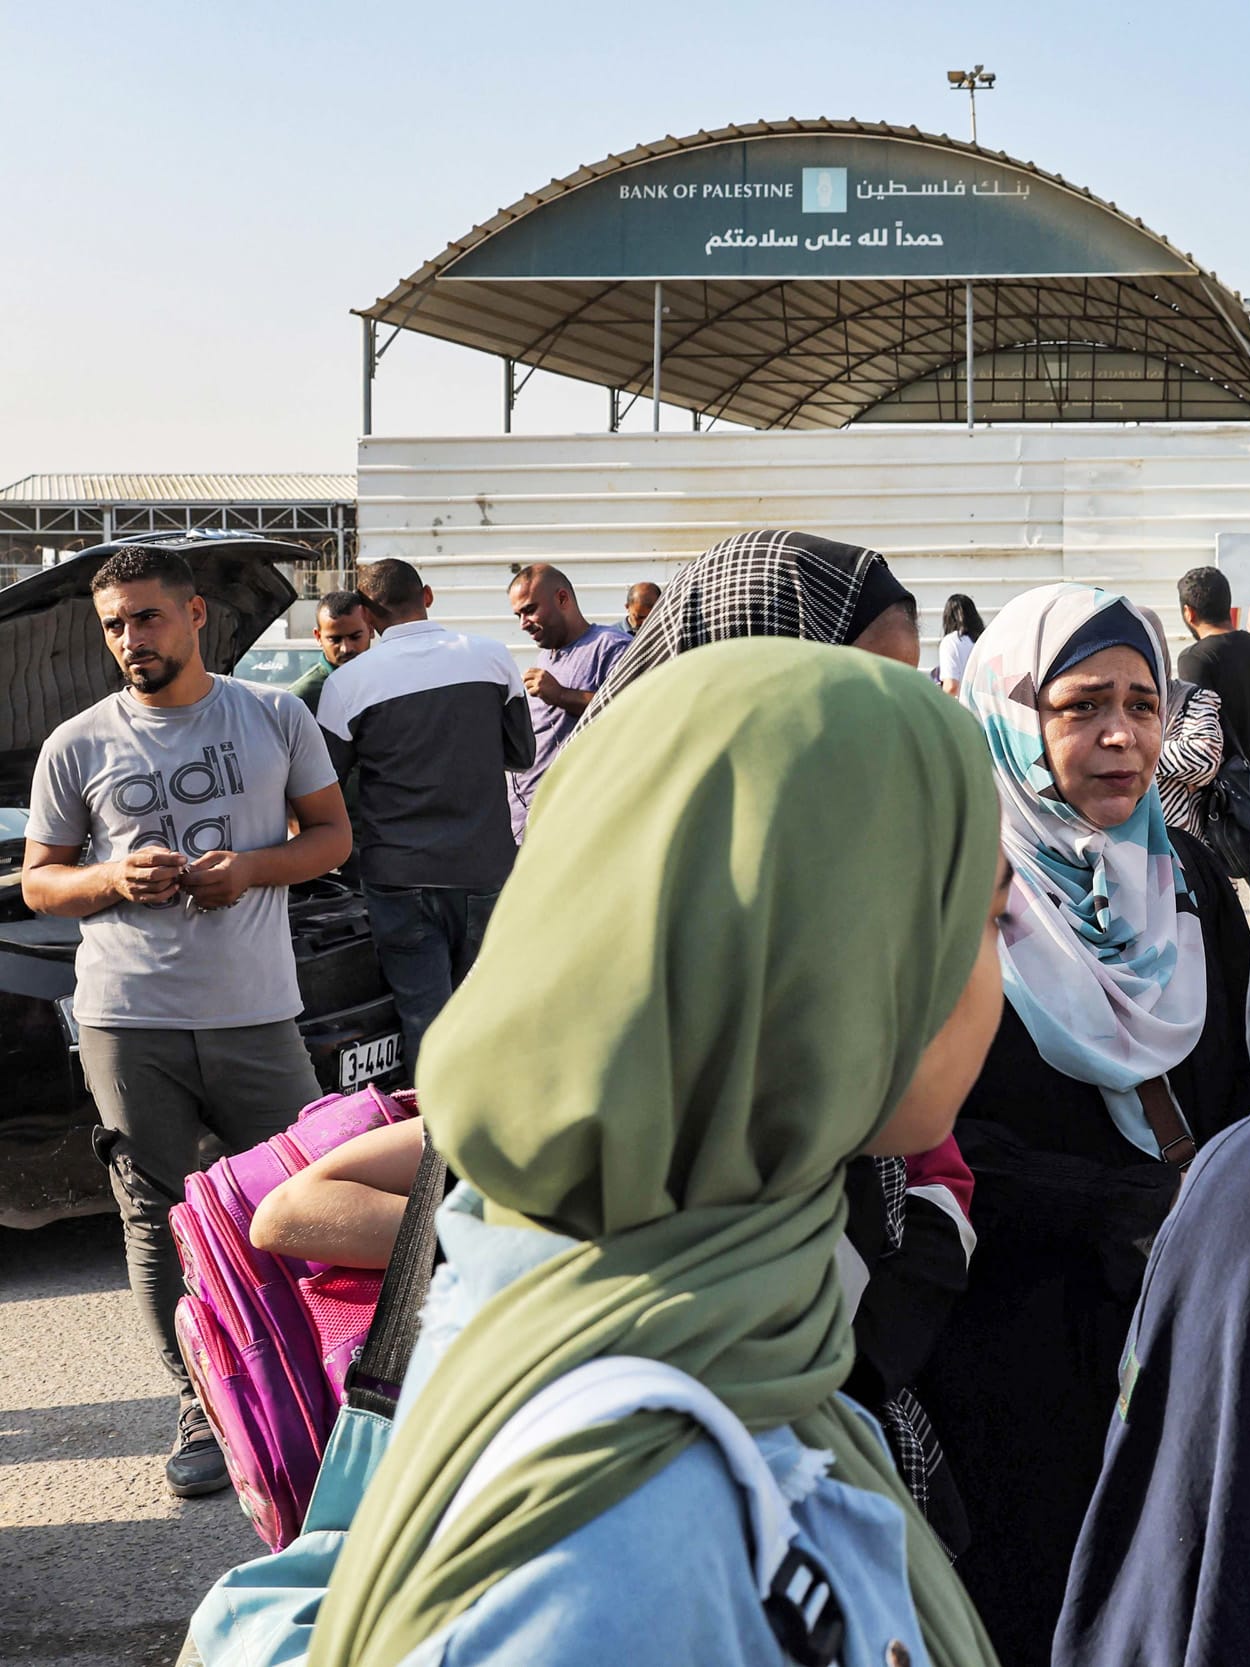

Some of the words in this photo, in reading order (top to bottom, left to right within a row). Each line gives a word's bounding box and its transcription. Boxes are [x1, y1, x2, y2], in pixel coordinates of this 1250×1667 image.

[620, 185, 668, 199] BANK
[673, 184, 698, 198] OF
[702, 183, 793, 198] PALESTINE
[705, 228, 798, 255] سلامتكم
[805, 228, 852, 251] على
[858, 228, 888, 247] لله
[111, 741, 245, 817] adi
